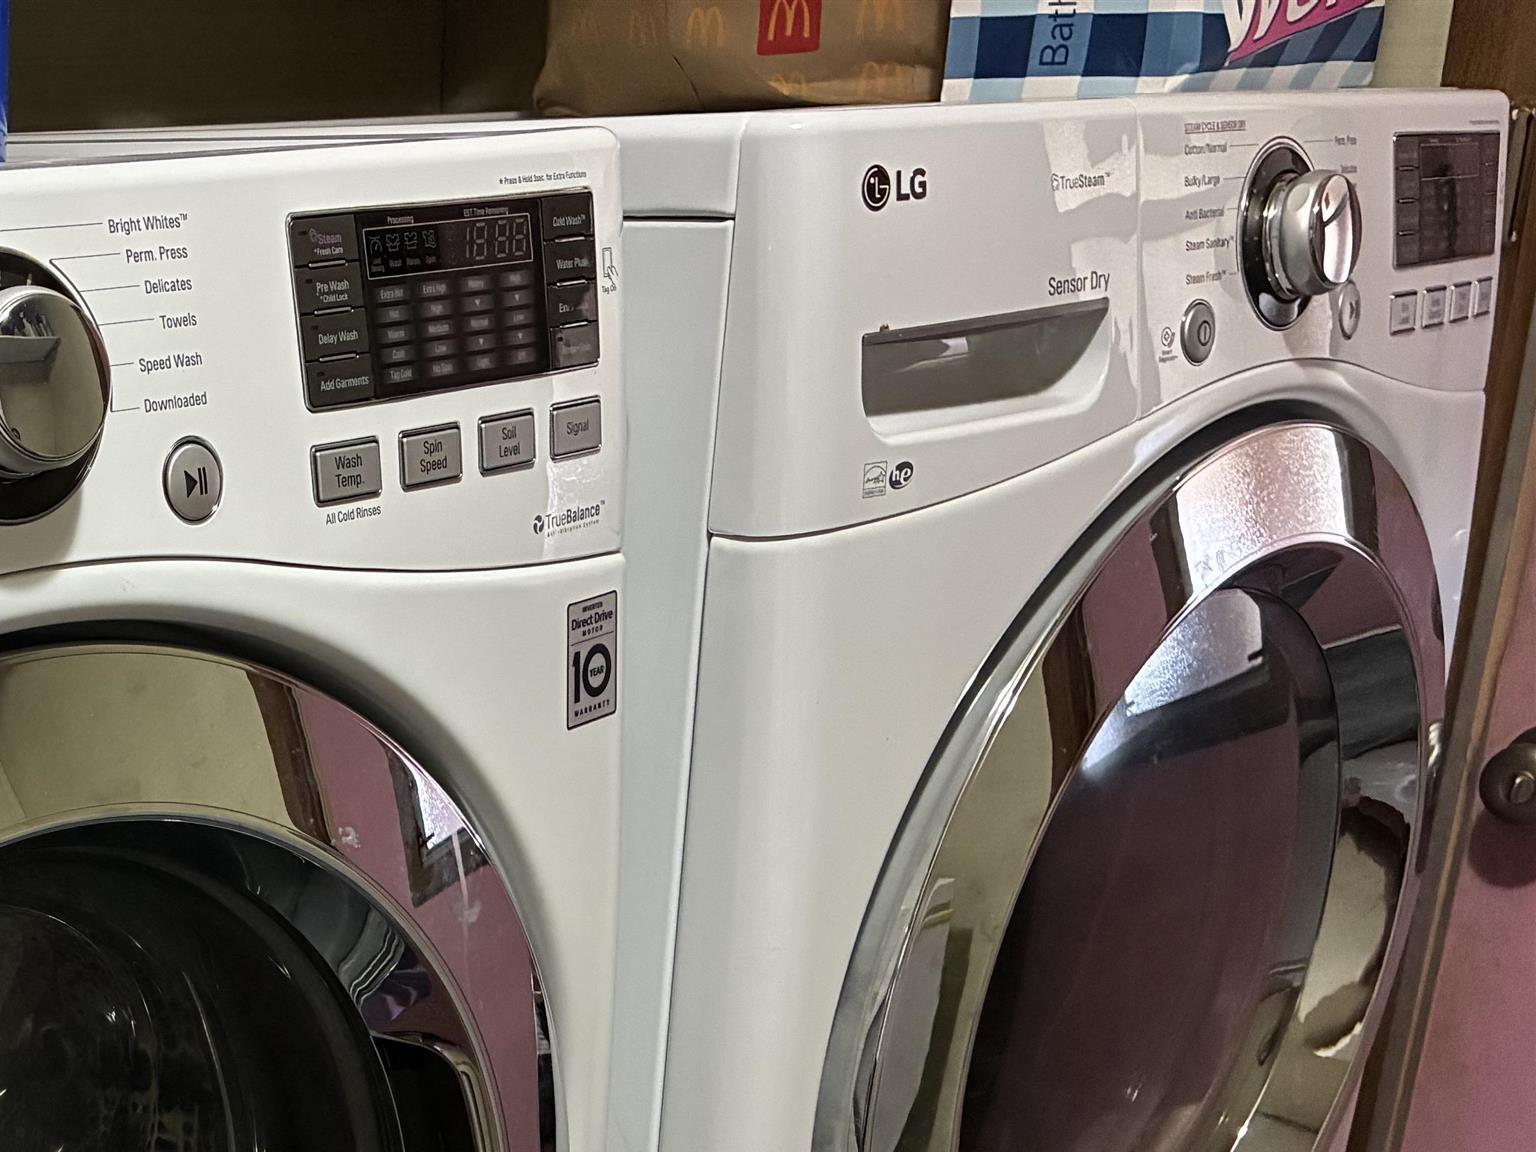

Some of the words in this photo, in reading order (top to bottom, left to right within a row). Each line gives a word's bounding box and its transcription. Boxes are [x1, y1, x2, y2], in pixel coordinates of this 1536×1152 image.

[896, 168, 927, 201] LG
[108, 217, 142, 235] Bright
[126, 248, 157, 264] Perm.
[158, 246, 188, 260] Press
[144, 277, 193, 294] Delicates
[316, 282, 329, 293] Pre
[329, 279, 350, 291] Wash
[1048, 276, 1088, 296] Sensor
[1091, 271, 1110, 292] Dry
[159, 312, 198, 329] Towels
[318, 333, 337, 345] Delay
[338, 330, 359, 342] Wash
[138, 356, 172, 374] Speed
[173, 352, 203, 368] Wash
[320, 379, 335, 392] Add
[335, 376, 370, 389] Garments
[144, 391, 208, 413] Downloaded
[502, 426, 517, 440] Soil
[566, 417, 589, 436] Signal
[423, 440, 443, 457] Spin
[499, 442, 520, 458] Level
[335, 453, 363, 470] Wash
[420, 456, 447, 475] Speed
[335, 473, 365, 488] Temp.
[326, 513, 336, 525] All
[338, 509, 355, 523] Cold
[356, 506, 381, 519] Rinses
[571, 615, 593, 631] Direct
[594, 610, 613, 624] Drive
[582, 625, 603, 636] MOTOR
[572, 643, 612, 704] 10
[590, 665, 604, 678] YEAR
[574, 699, 610, 718] WARRANTY
